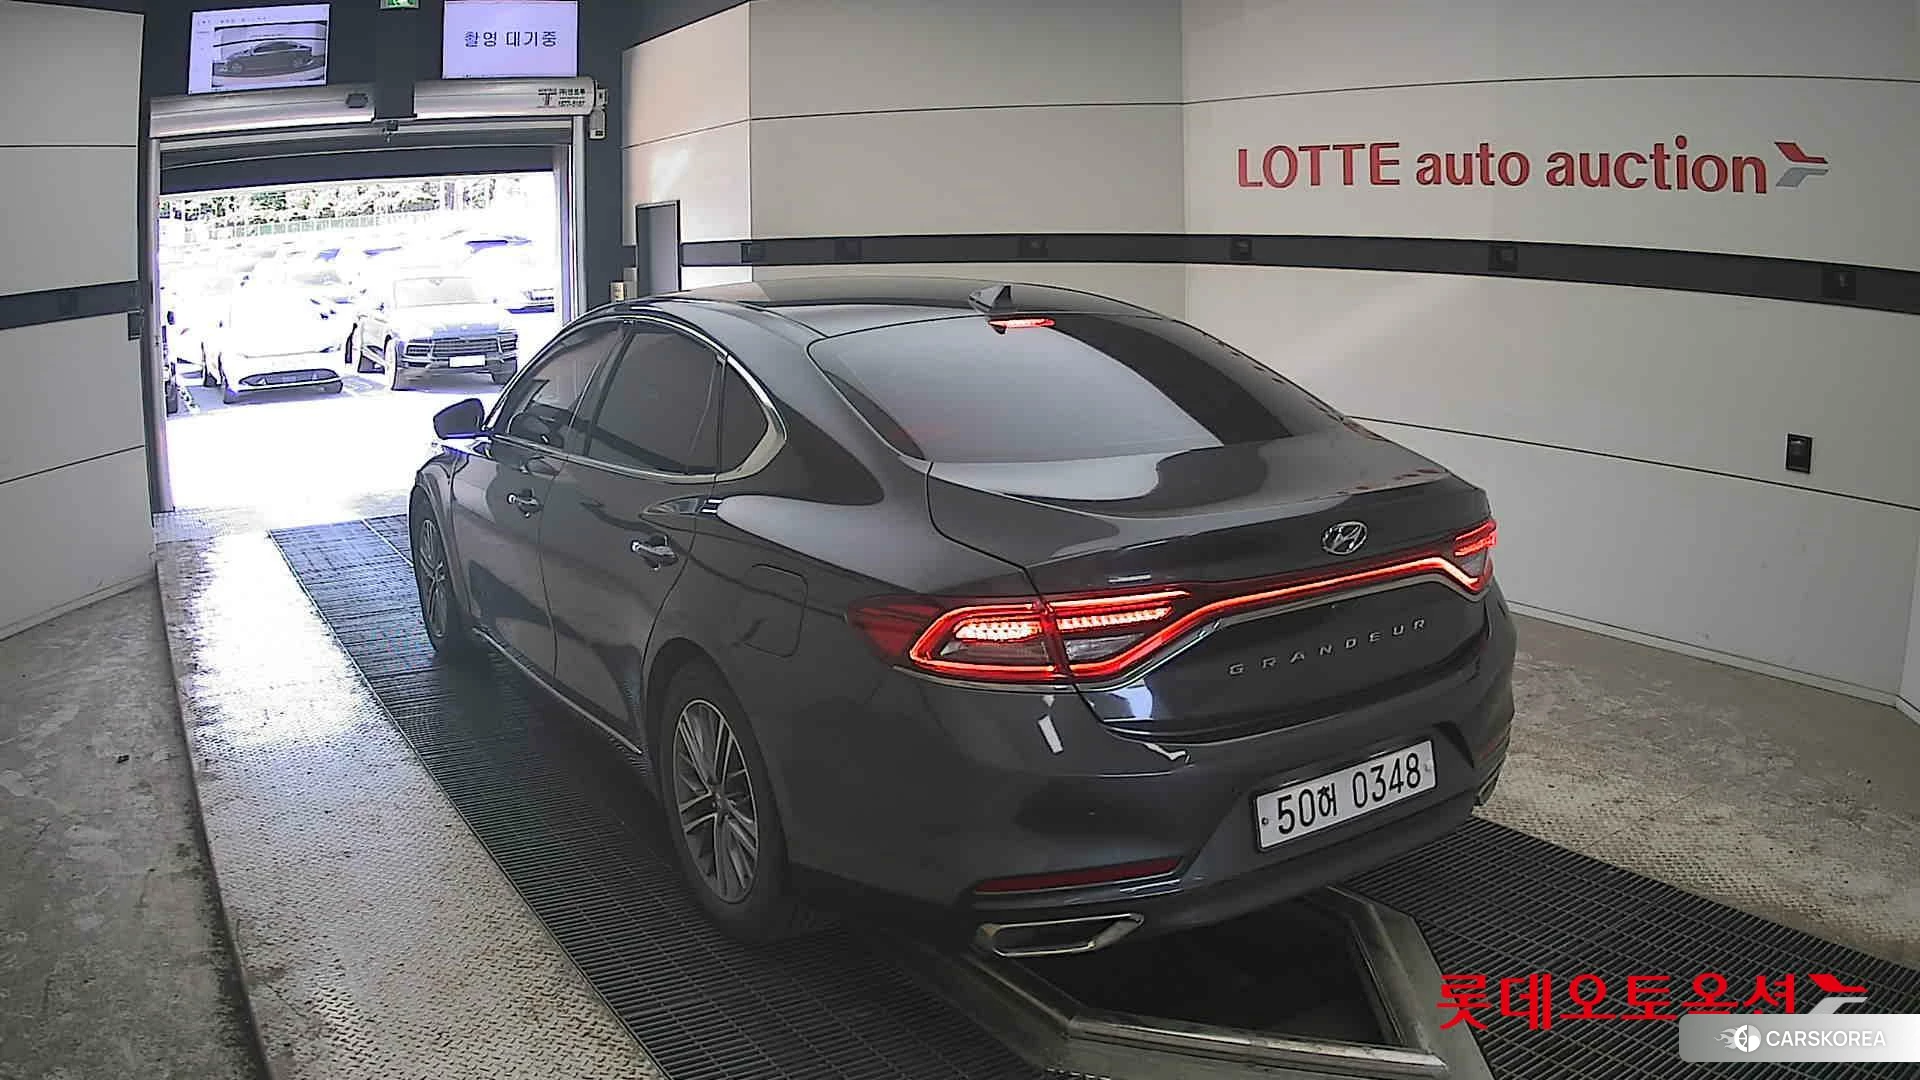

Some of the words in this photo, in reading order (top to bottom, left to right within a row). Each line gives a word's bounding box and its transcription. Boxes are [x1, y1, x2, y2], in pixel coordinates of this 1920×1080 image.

[464, 31, 498, 48] 촬영
[505, 31, 558, 48] 대기중
[1237, 143, 1398, 189] LOTTE
[1416, 143, 1530, 187] auto
[1546, 136, 1766, 194] auction
[1229, 618, 1426, 676] GRANDEUR
[1277, 782, 1337, 835] 50허
[1352, 752, 1422, 809] 0348
